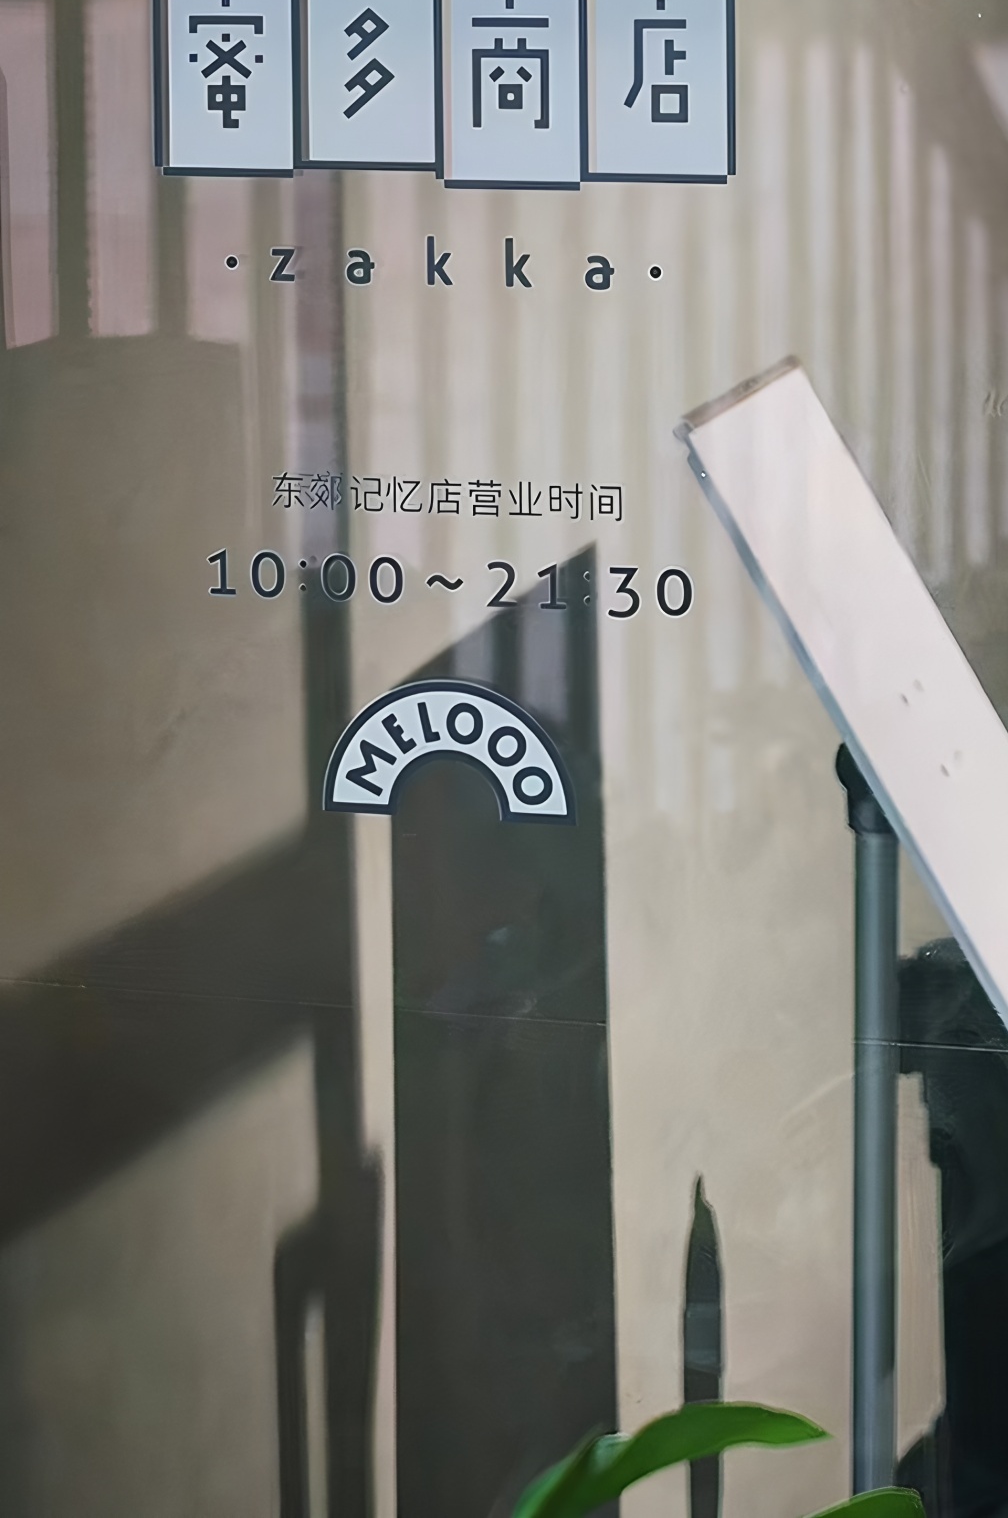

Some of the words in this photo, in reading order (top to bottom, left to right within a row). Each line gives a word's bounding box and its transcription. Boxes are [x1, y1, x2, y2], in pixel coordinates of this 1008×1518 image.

[272, 471, 623, 522] 东郊记忆店营业时间
[345, 692, 553, 806] MELOOO
